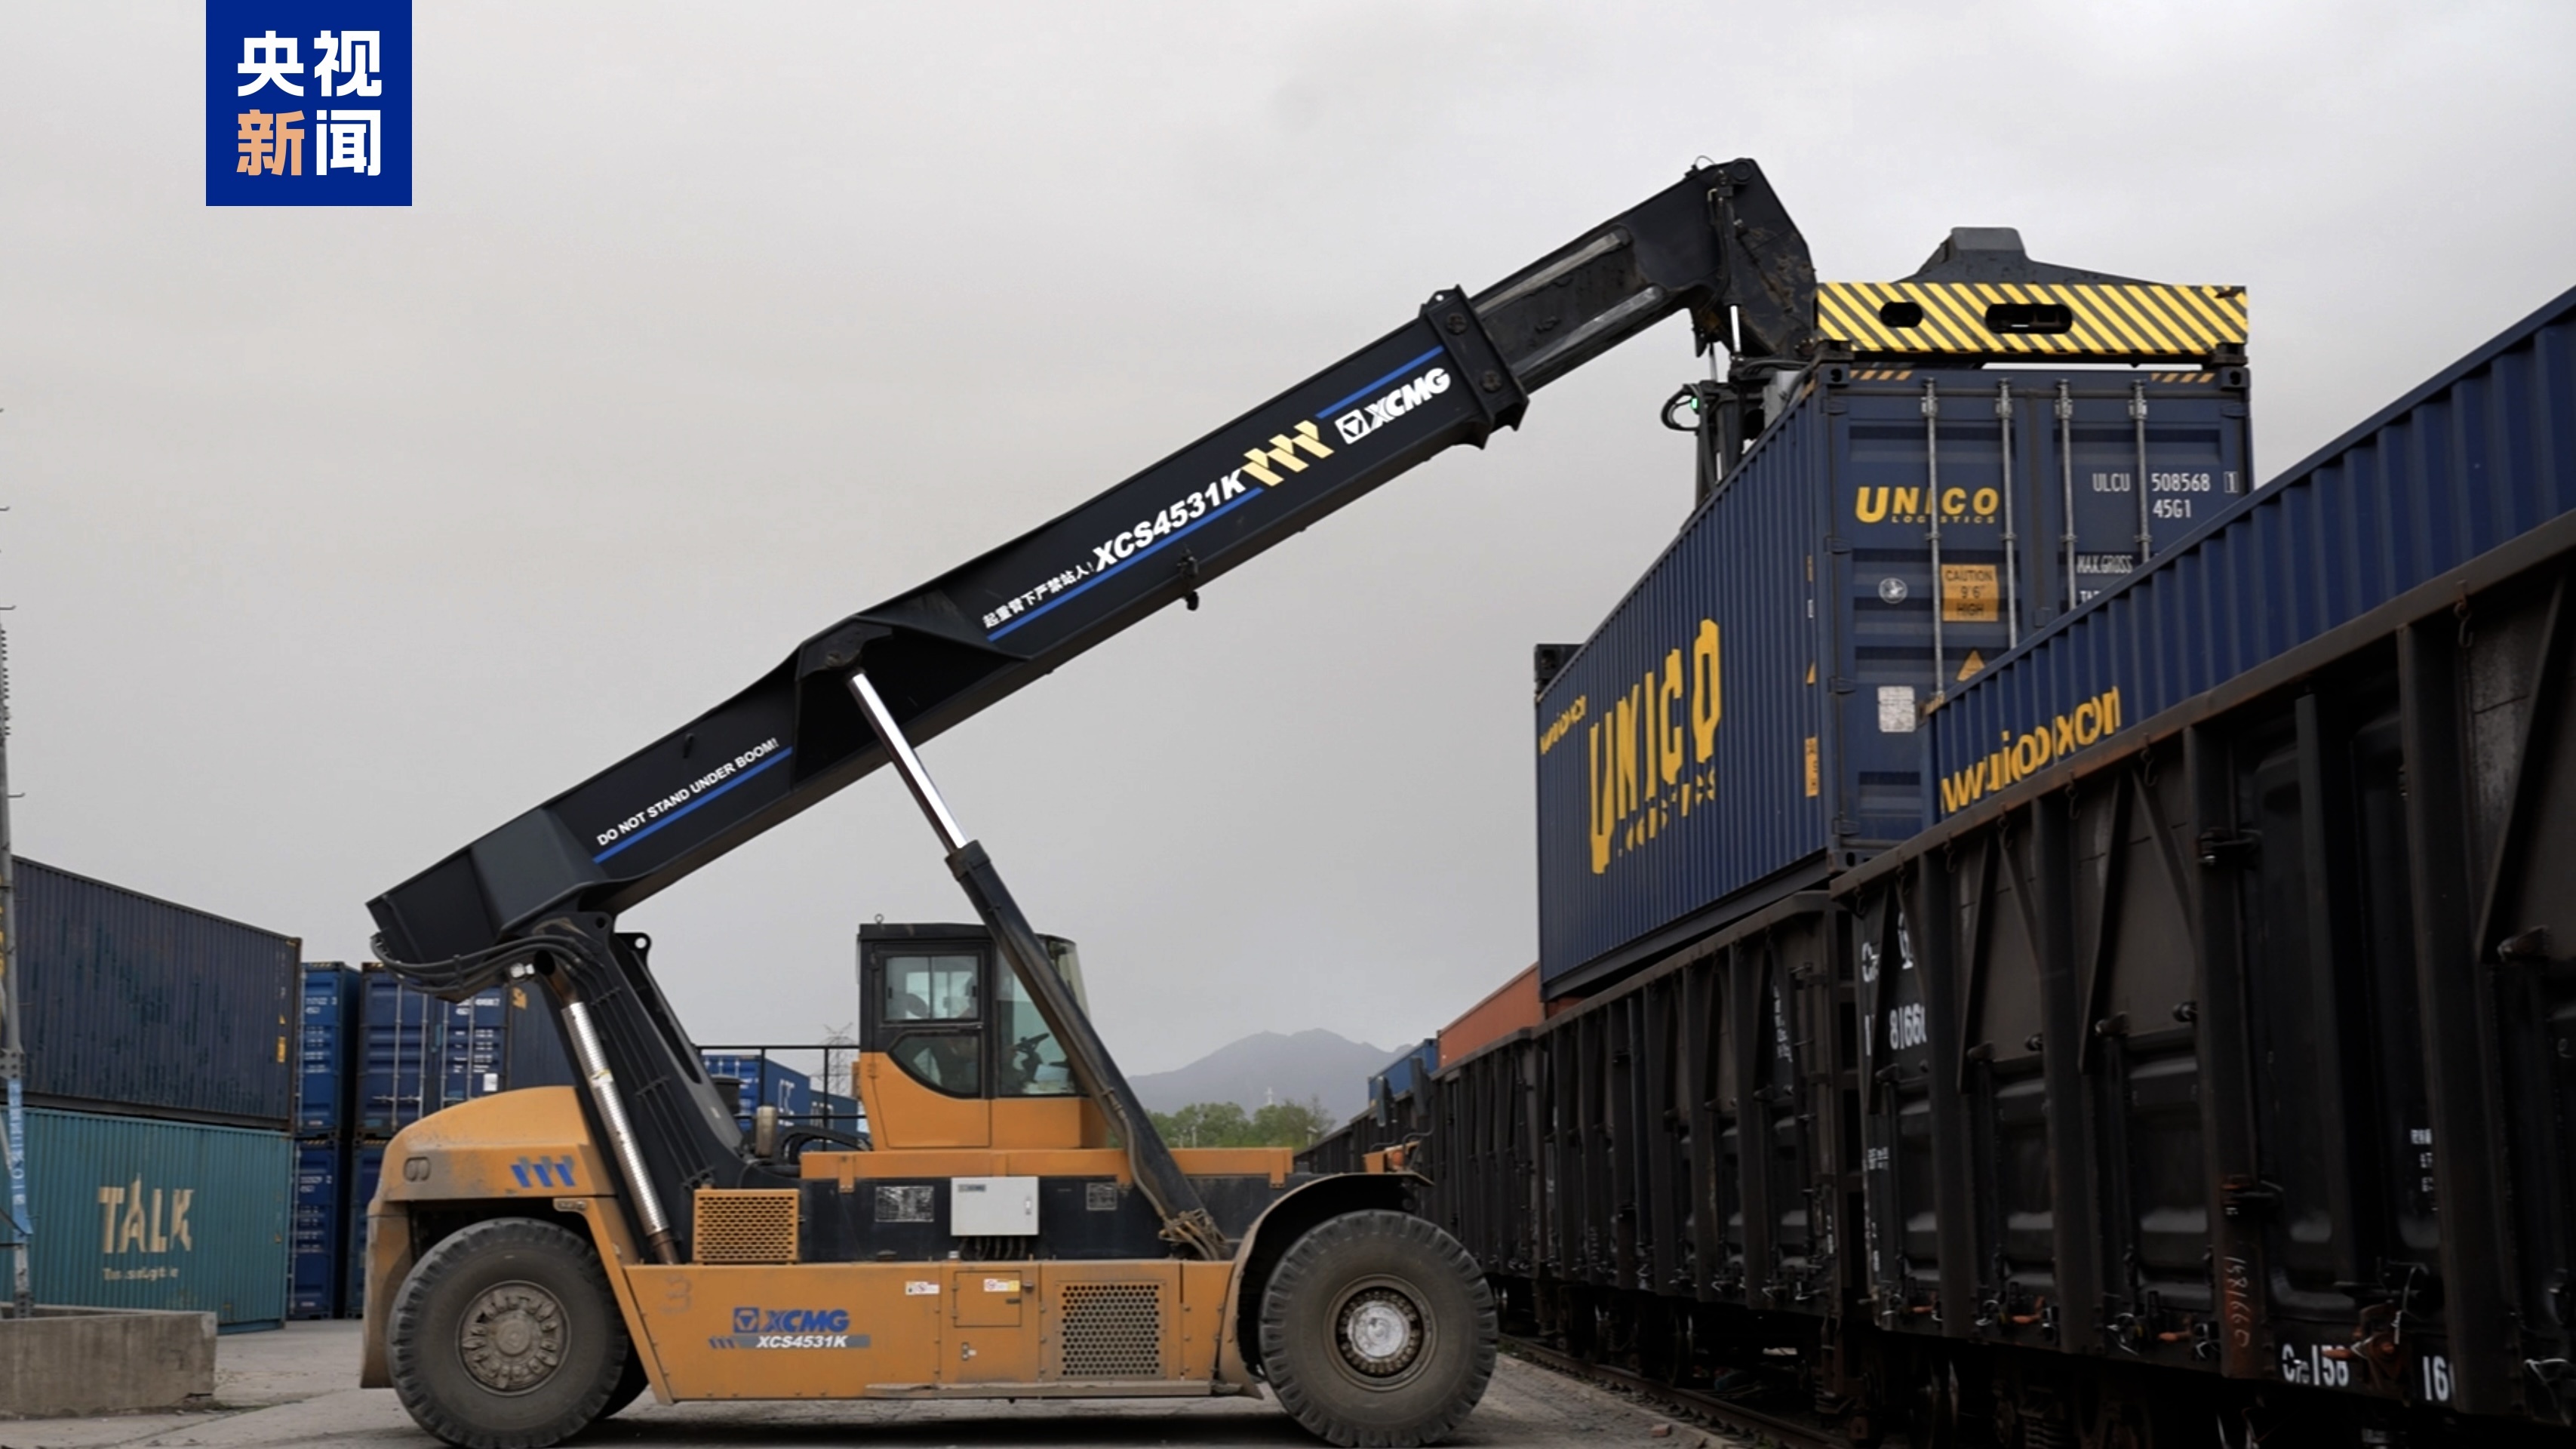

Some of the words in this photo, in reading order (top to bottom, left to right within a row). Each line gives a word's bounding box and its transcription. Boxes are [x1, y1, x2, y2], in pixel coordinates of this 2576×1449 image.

[1364, 368, 1450, 431] XCMG
[2092, 473, 2131, 491] ULCU
[2151, 473, 2211, 491] 508568
[1855, 487, 1999, 523] UNICO
[2153, 499, 2191, 518] 45G1
[1093, 469, 1246, 572] XCS4531K
[1945, 570, 1993, 581] CAUTION
[1957, 604, 1984, 616] HIGH
[1589, 619, 1721, 874] UNICO
[597, 829, 618, 846] DO
[618, 812, 647, 834] NOT
[647, 789, 690, 818] STAND
[690, 762, 736, 793] UNDER
[735, 737, 779, 768] BOOM!
[98, 1172, 194, 1254] TALK
[764, 1309, 850, 1333] XCMG
[756, 1335, 848, 1348] XCS4531K
